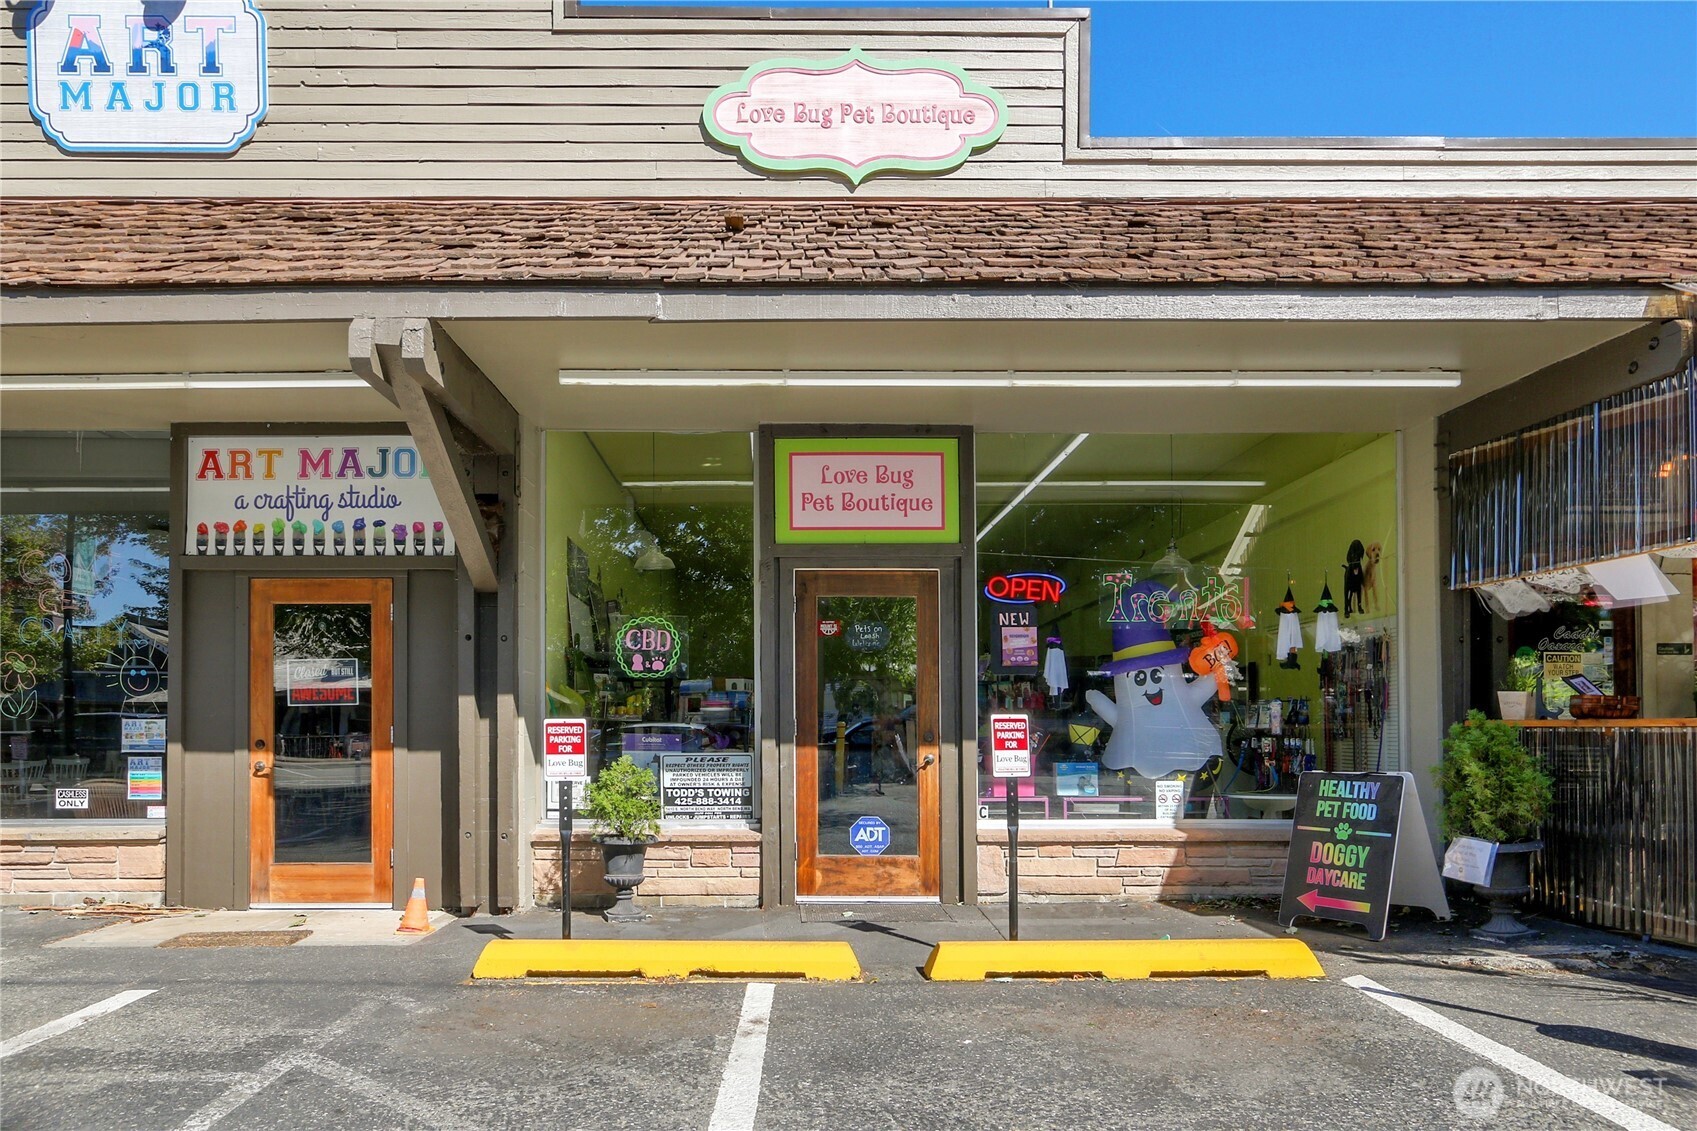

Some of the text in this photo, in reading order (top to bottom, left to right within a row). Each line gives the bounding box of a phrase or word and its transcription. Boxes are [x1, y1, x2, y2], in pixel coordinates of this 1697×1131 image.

[57, 14, 237, 77] ART
[58, 80, 239, 112] MAJOR
[735, 102, 977, 131] Love Bug Pet Boutique
[196, 447, 433, 481] ART MAJO
[821, 464, 914, 490] Love Bug
[234, 485, 402, 521] a crafting studio
[801, 492, 933, 518] Pet Boutique
[988, 576, 1061, 603] OPEN
[999, 612, 1030, 626] NEW
[854, 624, 871, 633] Pets
[625, 628, 671, 652] CBD
[1203, 639, 1232, 668] BO!
[1546, 654, 1581, 662] CAUTION
[294, 664, 354, 680] Closed BUT STILL
[291, 684, 355, 701] AWESOME
[547, 726, 583, 734] RESERVED
[996, 731, 1025, 739] PARKING
[549, 736, 581, 744] PARKING
[1004, 741, 1018, 749] FOR
[558, 745, 573, 753] FOR
[548, 759, 584, 768] Love Bug
[996, 755, 1028, 764] Love Bug
[58, 790, 87, 799] CASHLESS
[666, 788, 750, 797] TODD'S TOWING
[1318, 779, 1381, 800] HEALTHY
[674, 797, 742, 806] 425-888-3414
[979, 806, 988, 819] C
[1315, 800, 1378, 821] PET FOOD
[854, 827, 886, 841] ADT
[1309, 841, 1370, 869] DOGGY
[1306, 866, 1368, 891] DAYCARE
